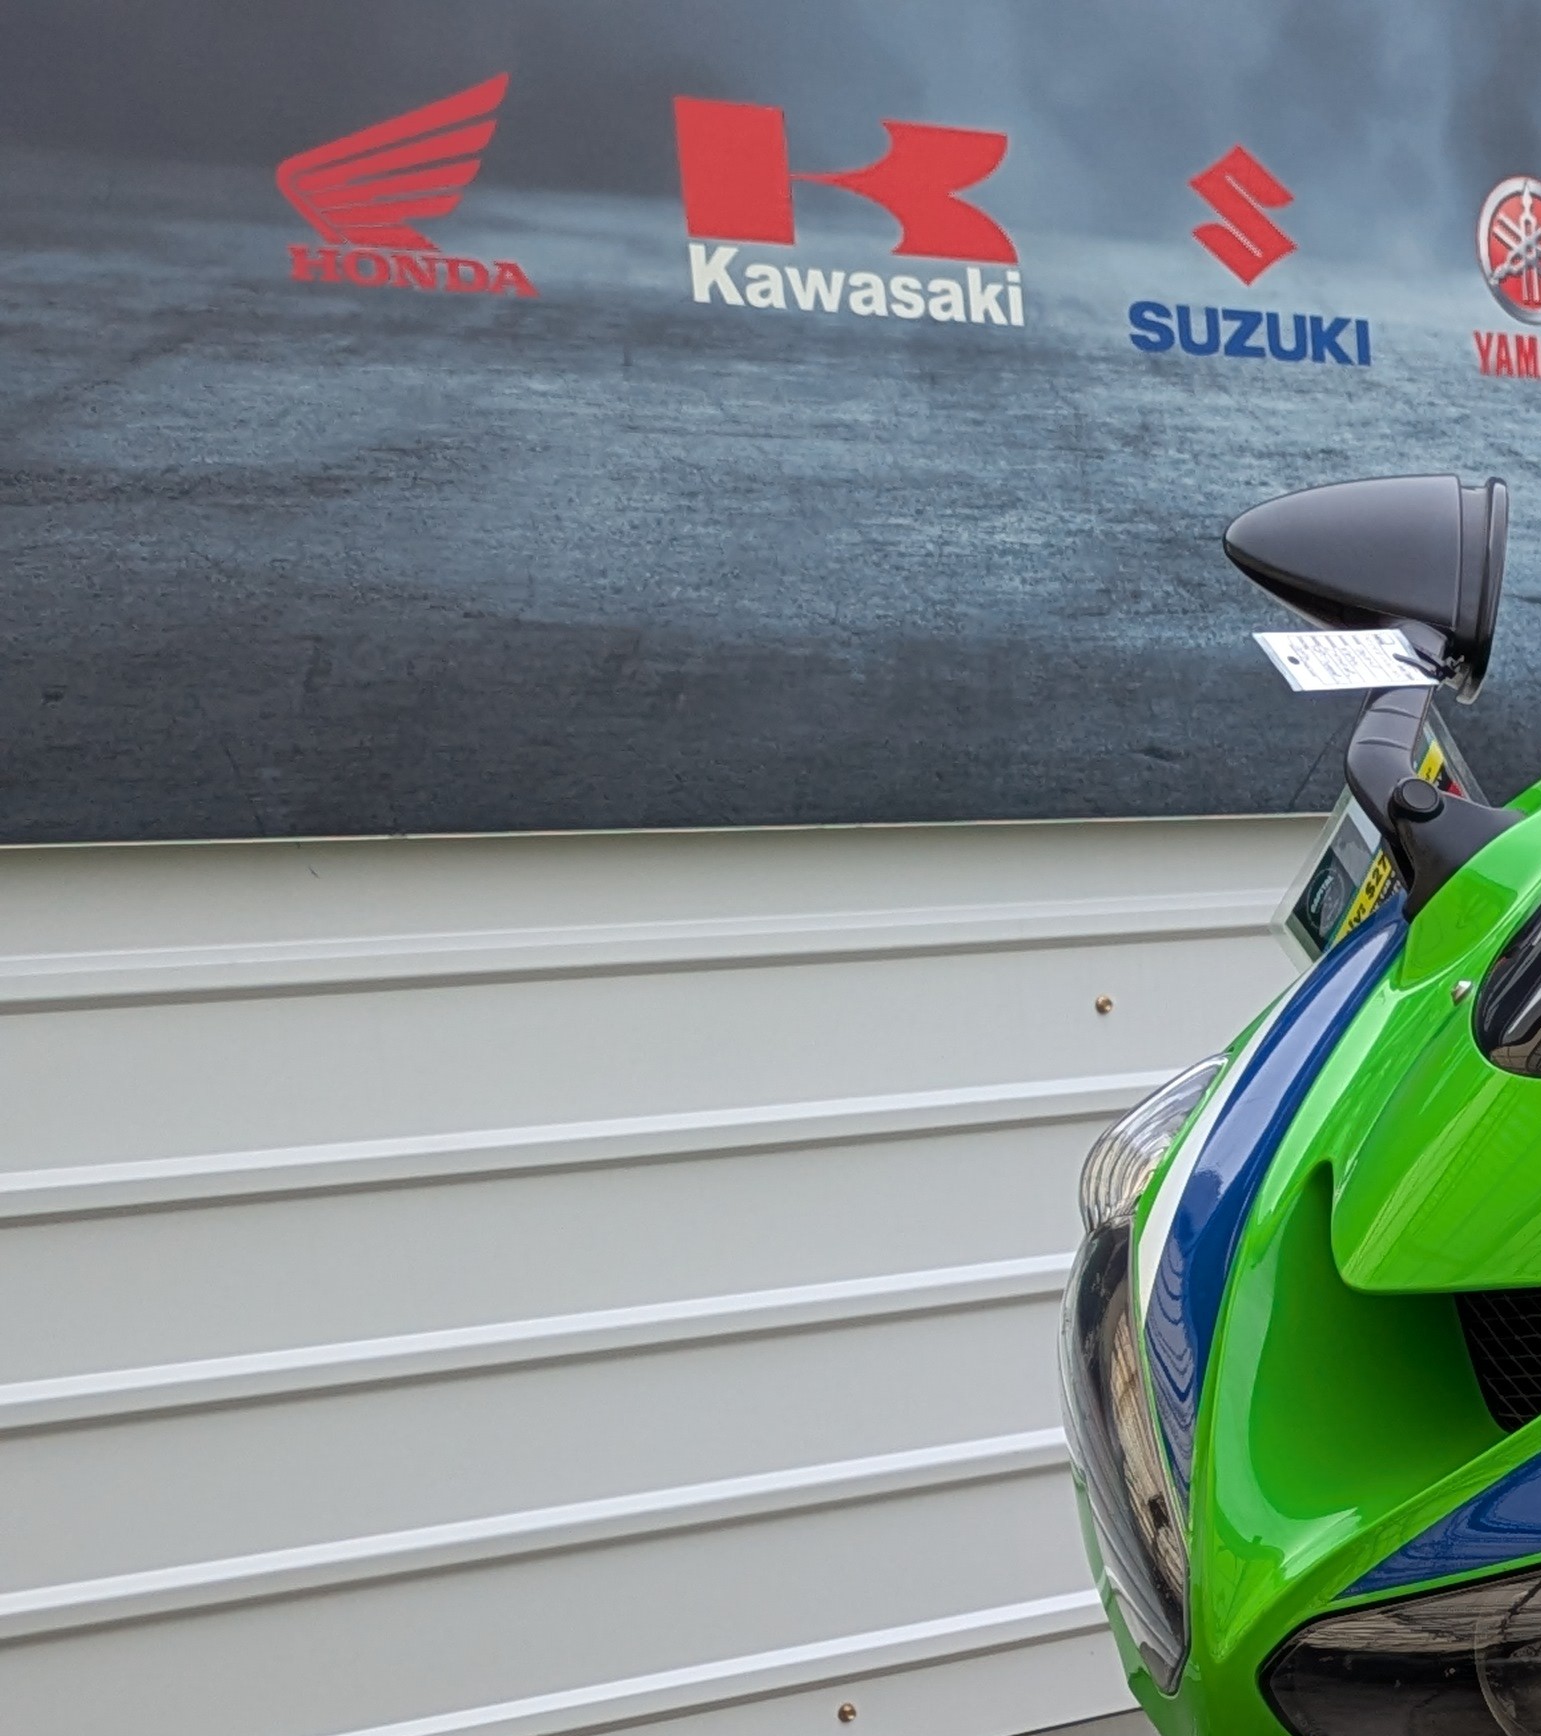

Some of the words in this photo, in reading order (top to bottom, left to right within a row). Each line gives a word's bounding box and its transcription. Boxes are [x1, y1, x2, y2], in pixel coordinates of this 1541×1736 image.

[286, 245, 540, 298] HONDA
[688, 242, 1026, 328] Kawasaki
[1128, 300, 1372, 367] SUZUKI
